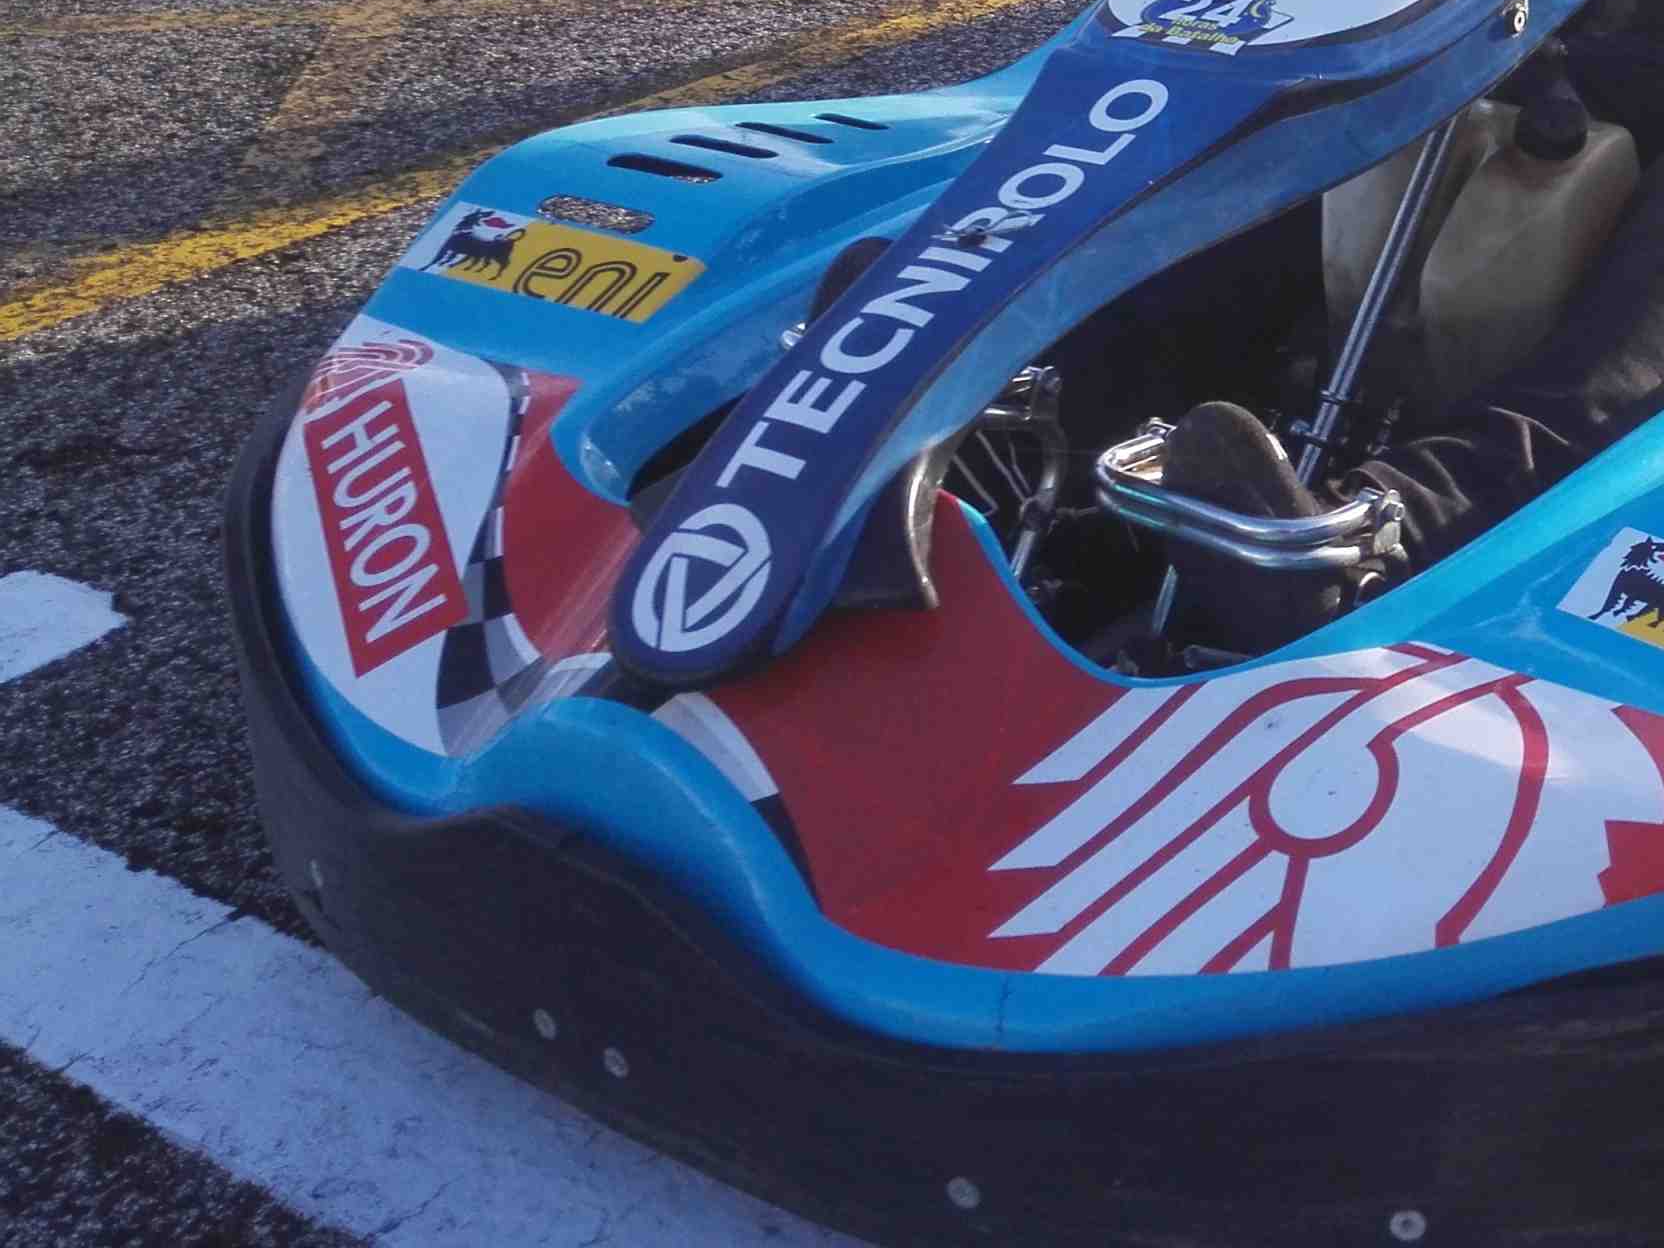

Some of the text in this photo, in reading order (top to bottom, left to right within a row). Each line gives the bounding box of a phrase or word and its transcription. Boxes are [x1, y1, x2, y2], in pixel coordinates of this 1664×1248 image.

[511, 247, 691, 320] eni
[720, 78, 1169, 490] TECNIROLO
[320, 399, 448, 645] HURON
